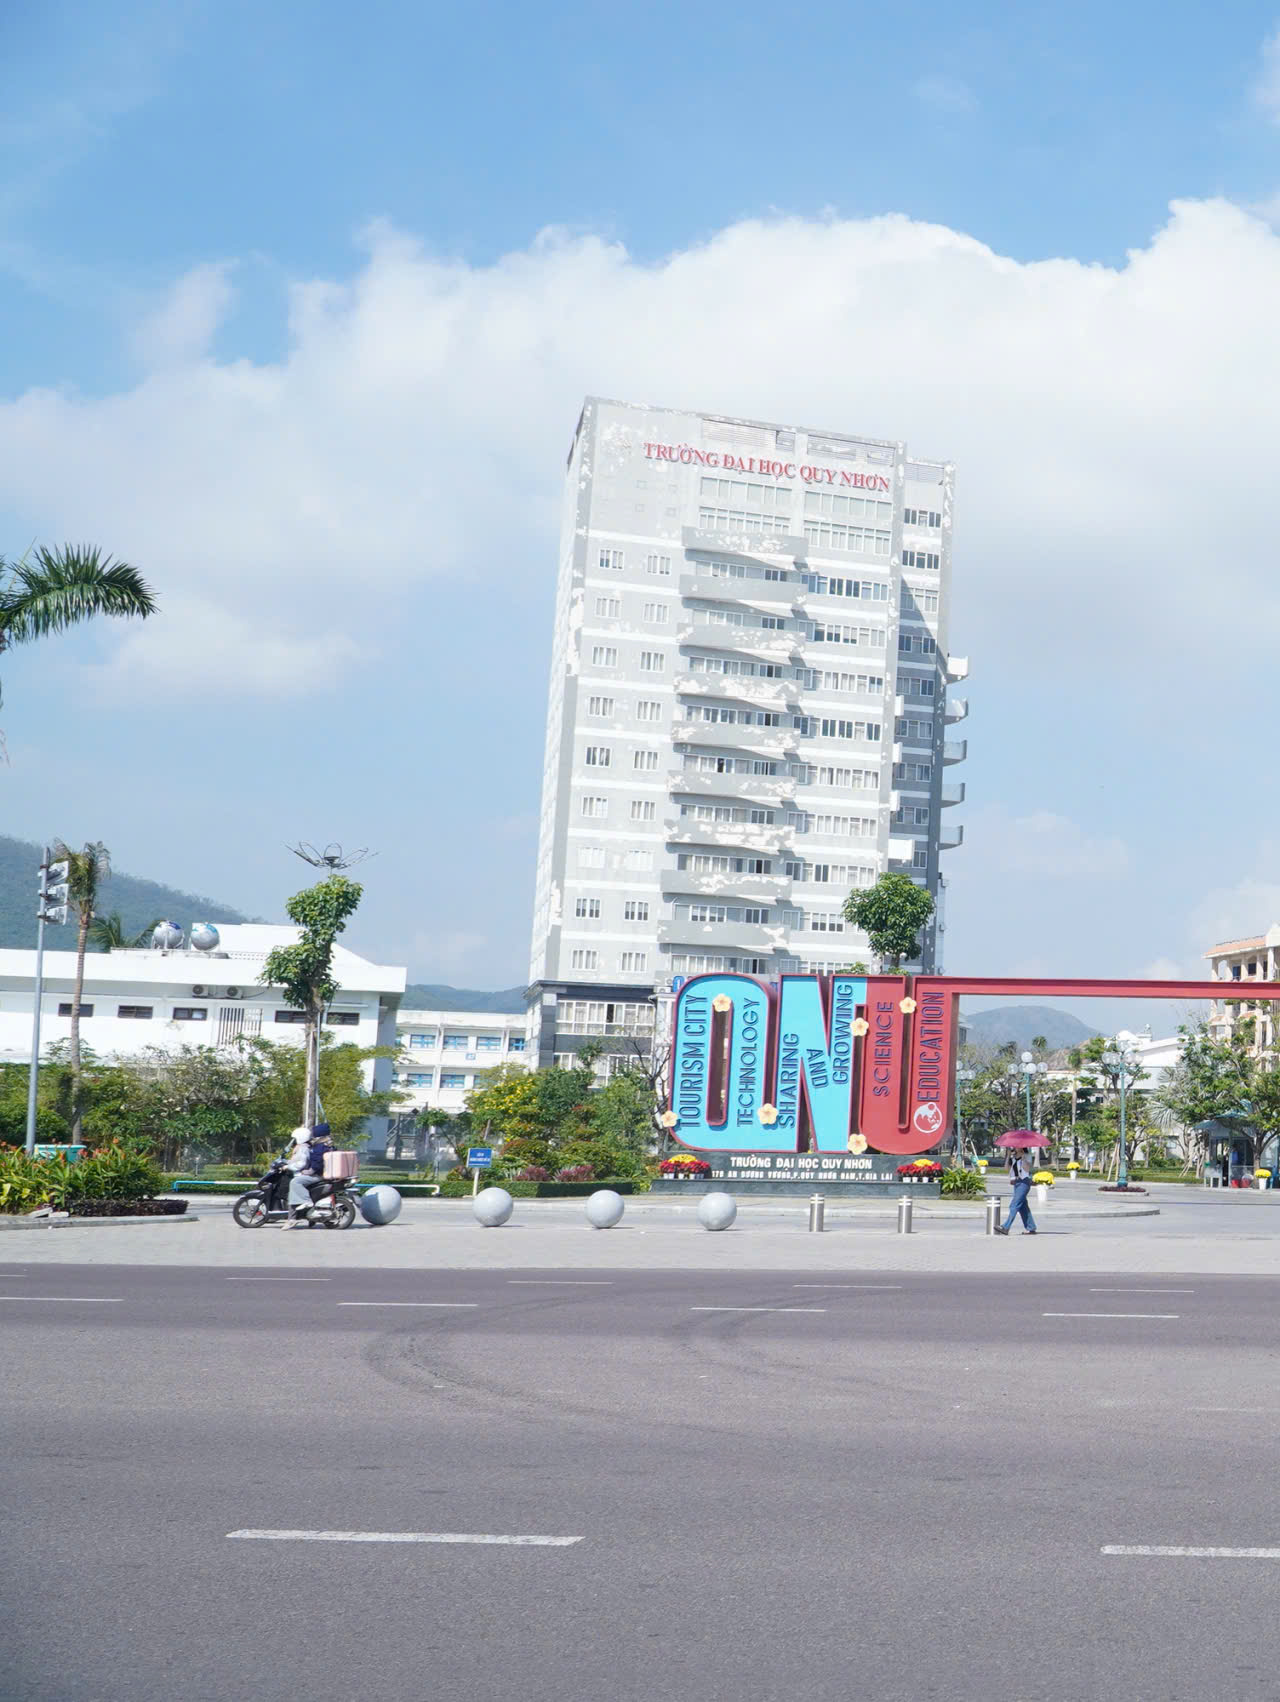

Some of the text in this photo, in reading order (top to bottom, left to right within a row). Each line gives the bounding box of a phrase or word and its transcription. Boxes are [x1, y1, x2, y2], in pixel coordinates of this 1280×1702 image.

[644, 442, 890, 492] TRƯỜNG ĐẠI HỌC QUY NHƠN
[677, 994, 708, 1128] TOURISM CITY
[737, 997, 760, 1128] TECHNOLOGY
[779, 1033, 800, 1129] SHARING
[806, 1048, 829, 1089] AND
[832, 984, 854, 1085] GROWING
[873, 1001, 894, 1097] SCIENCE
[917, 992, 945, 1102] EDUCATION
[730, 1154, 771, 1168] TRƯỜNG
[776, 1157, 794, 1171] ĐẠI
[798, 1157, 819, 1172] HỌC
[822, 1158, 842, 1169] QUY
